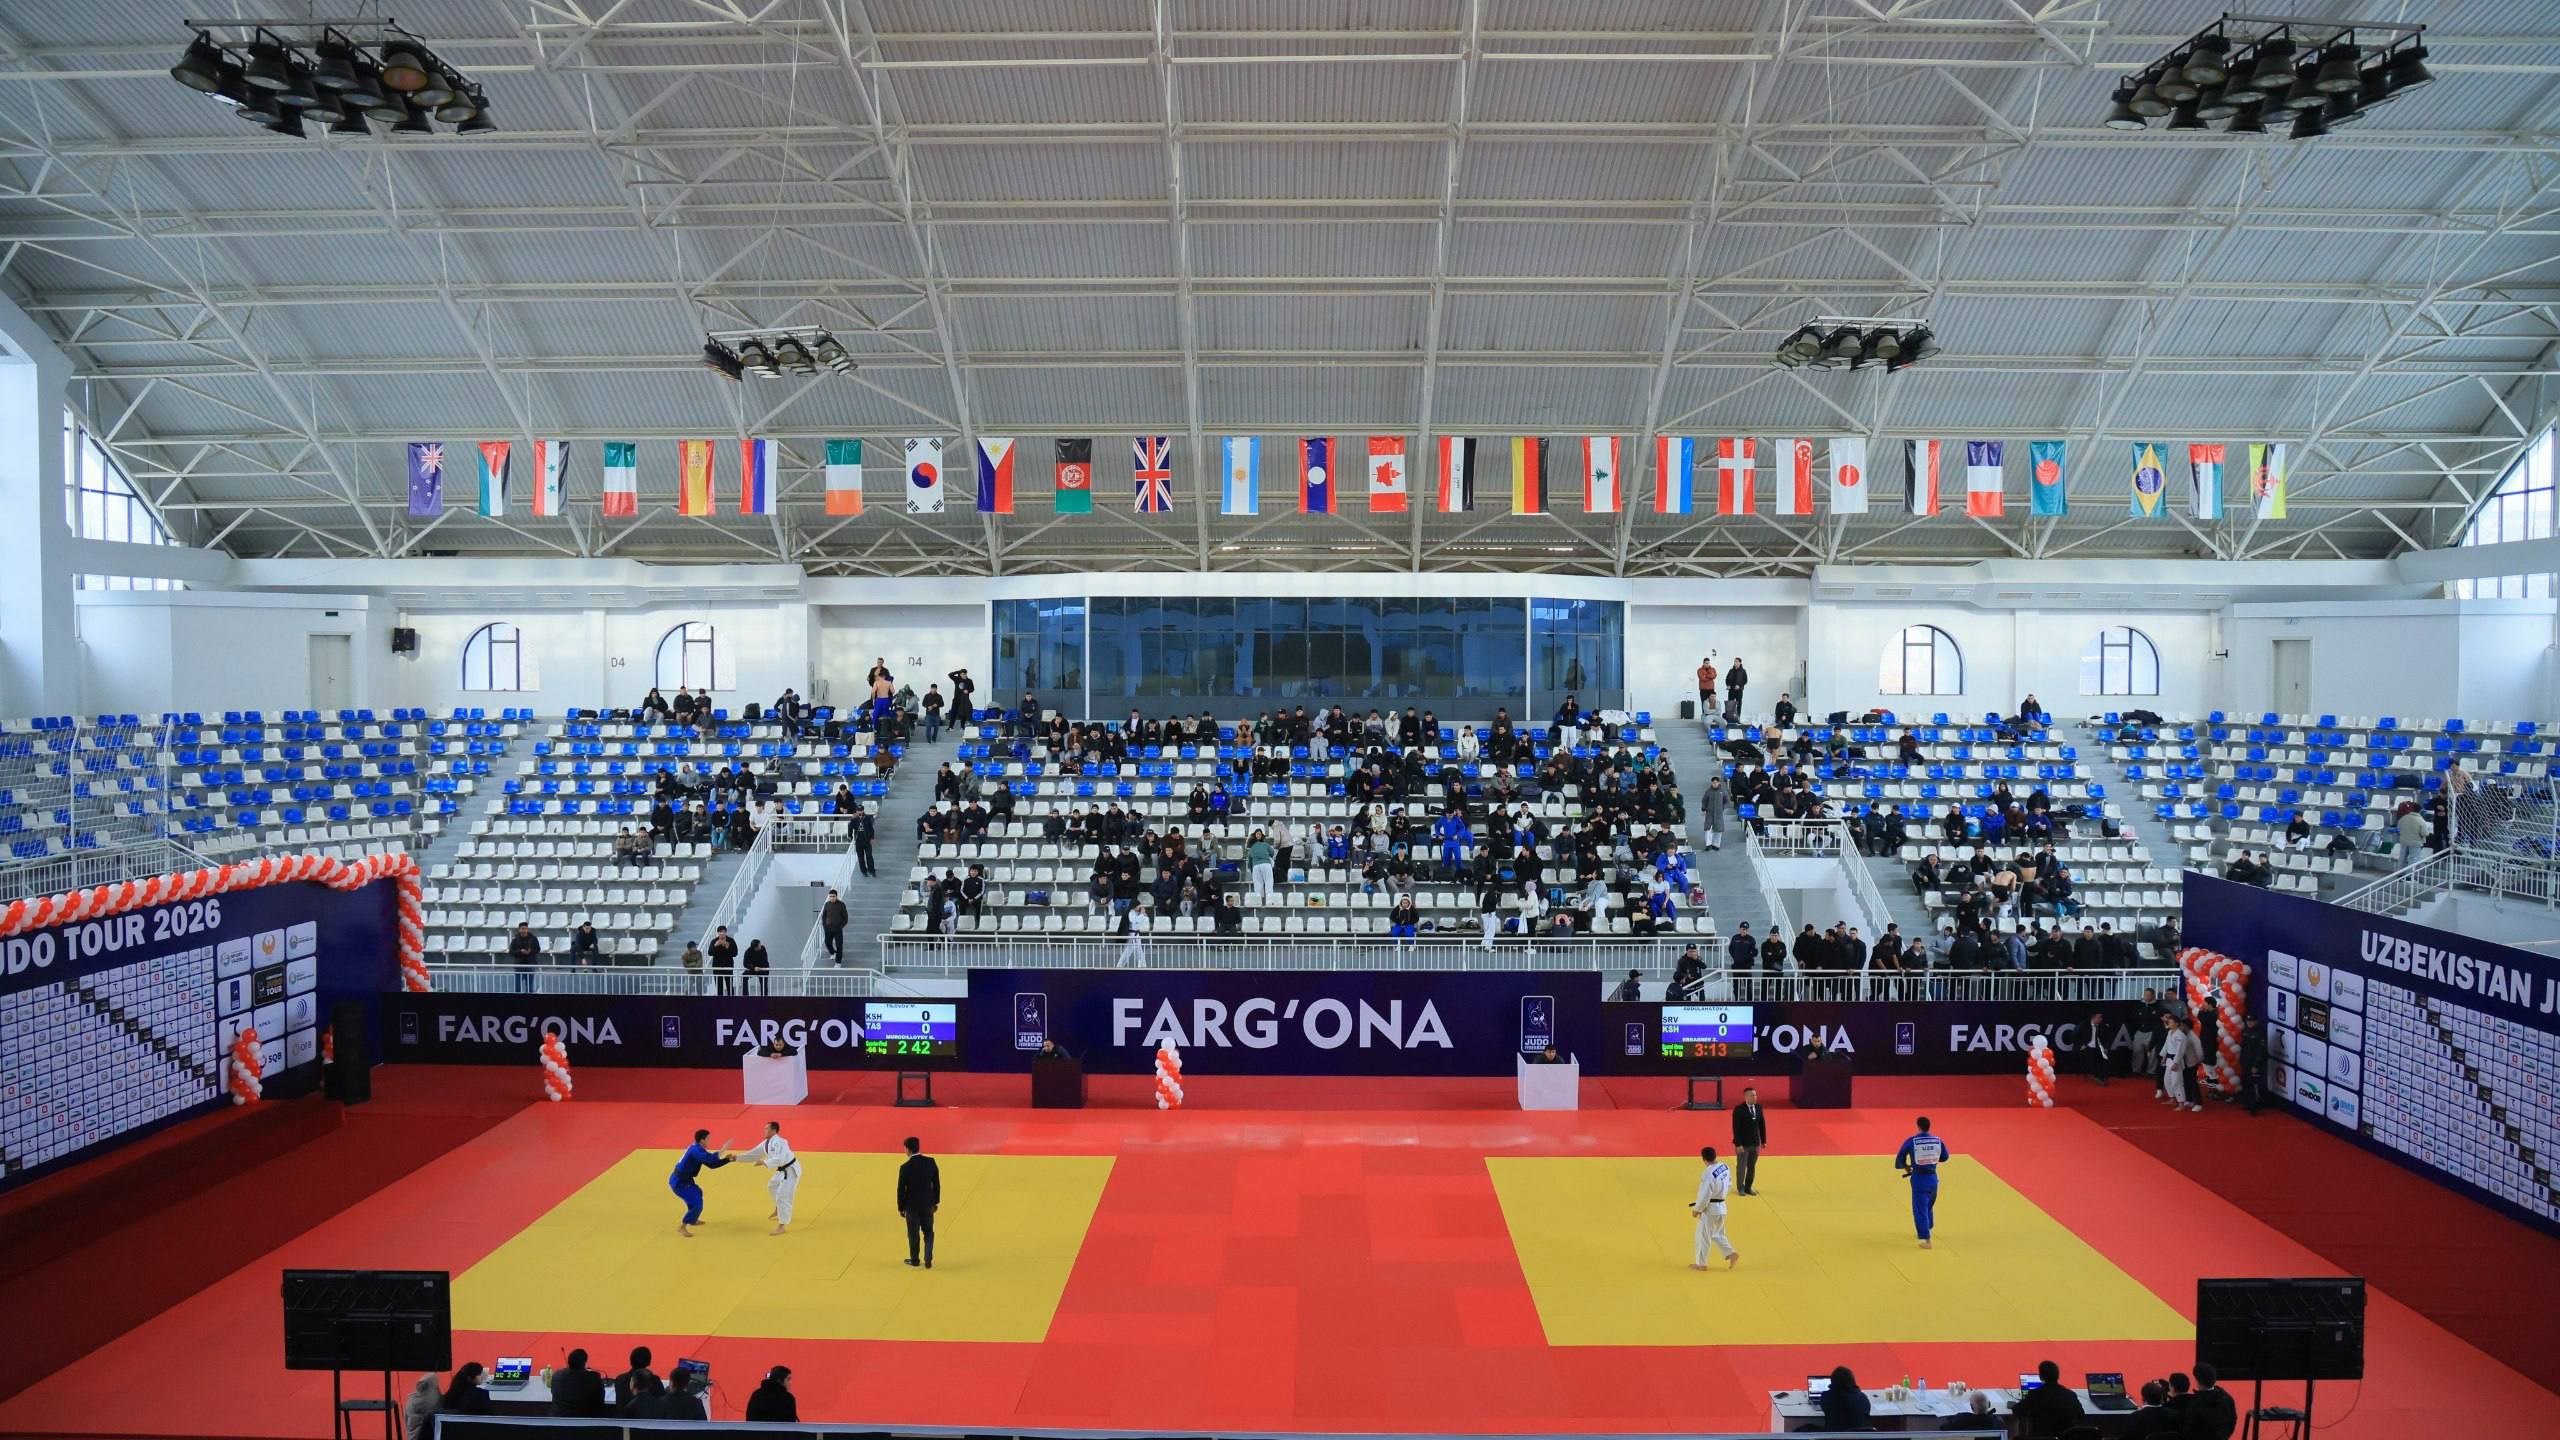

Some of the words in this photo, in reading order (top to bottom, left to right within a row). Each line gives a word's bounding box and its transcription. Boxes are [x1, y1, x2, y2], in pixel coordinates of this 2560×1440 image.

[64, 914, 146, 961] TOUR
[154, 898, 221, 941] 2026
[2361, 930, 2532, 1008] UZBEKISTAN
[2540, 978, 2560, 1015] J
[266, 985, 282, 996] TOUR
[922, 1010, 930, 1021] 0
[1662, 1016, 1679, 1024] SRV
[1719, 1013, 1728, 1024] 0
[866, 1022, 882, 1030] TAS
[921, 1023, 930, 1034] 0
[1662, 1025, 1679, 1033] KSH
[1718, 1025, 1728, 1037] 0
[2310, 1020, 2325, 1032] TOUR
[716, 1019, 865, 1048] FARG'ON
[1018, 1035, 1043, 1043] JUDO
[1524, 1038, 1549, 1046] JUDO
[1695, 1043, 1728, 1057] 3:13
[2299, 1088, 2321, 1103] CONDOR
